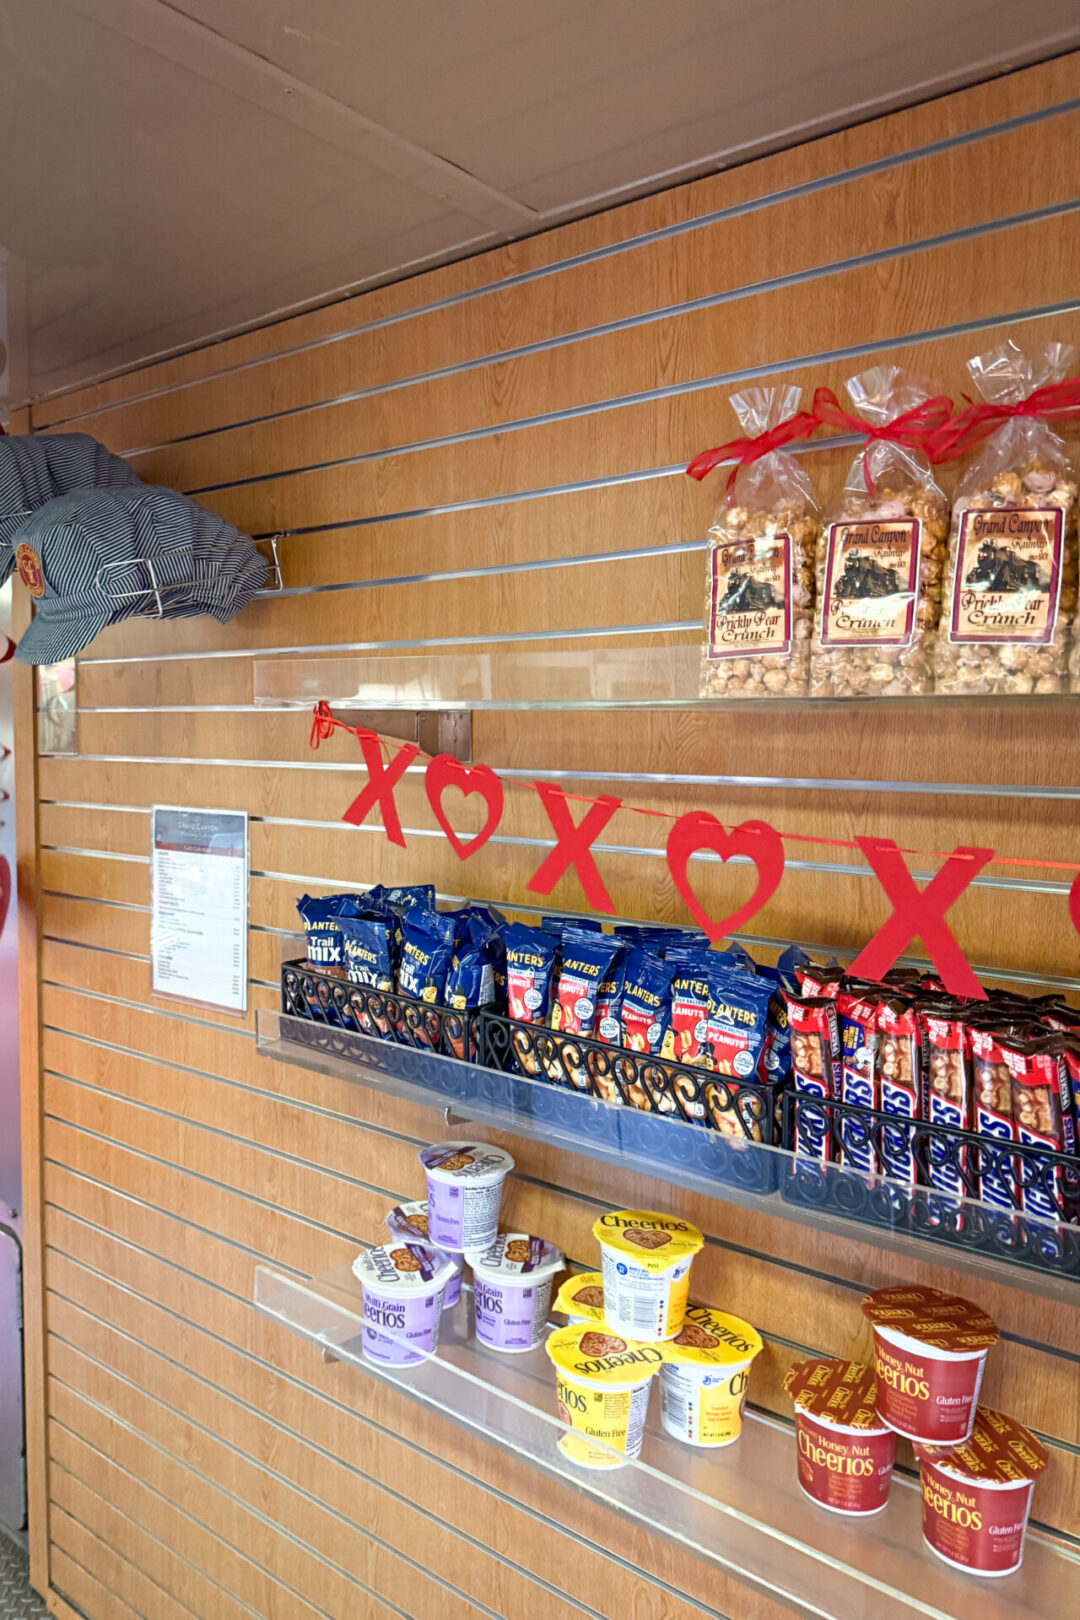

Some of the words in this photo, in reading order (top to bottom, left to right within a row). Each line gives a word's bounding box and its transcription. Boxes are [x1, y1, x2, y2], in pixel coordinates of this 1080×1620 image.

[973, 514, 1006, 536] Grand
[870, 525, 908, 550] Canyon
[716, 612, 752, 632] Prickly
[753, 609, 781, 627] Pear
[967, 609, 1036, 625] Crunch
[721, 626, 775, 642] Crunch
[310, 936, 334, 947] Trail
[307, 944, 342, 963] mix
[403, 941, 430, 966] ANTERS
[506, 950, 544, 968] ANTERS
[562, 957, 602, 977] ANTERS
[347, 969, 378, 988] mix
[674, 978, 709, 996] ANTER
[624, 980, 661, 1007] PLANTERS
[621, 1009, 653, 1025] PEANUTS
[707, 1000, 756, 1028] PLANTERS
[708, 1031, 745, 1049] PEANUTS
[600, 1215, 689, 1232] Cheerios
[483, 1284, 503, 1299] Grain
[364, 1302, 406, 1329] eerios
[382, 1301, 406, 1313] Grain
[684, 1305, 755, 1353] Cheerios
[574, 1347, 663, 1375] Cheerios
[904, 1361, 925, 1378] Nut
[875, 1358, 930, 1401] eerios
[557, 1382, 588, 1413] rios
[935, 1395, 961, 1406] Gluten
[585, 1426, 611, 1438] Gluten
[798, 1429, 875, 1477] Cheerios
[818, 1435, 849, 1456] Honey
[851, 1445, 870, 1457] Nut
[955, 1491, 977, 1508] Nut
[988, 1525, 1014, 1537] Gluten
